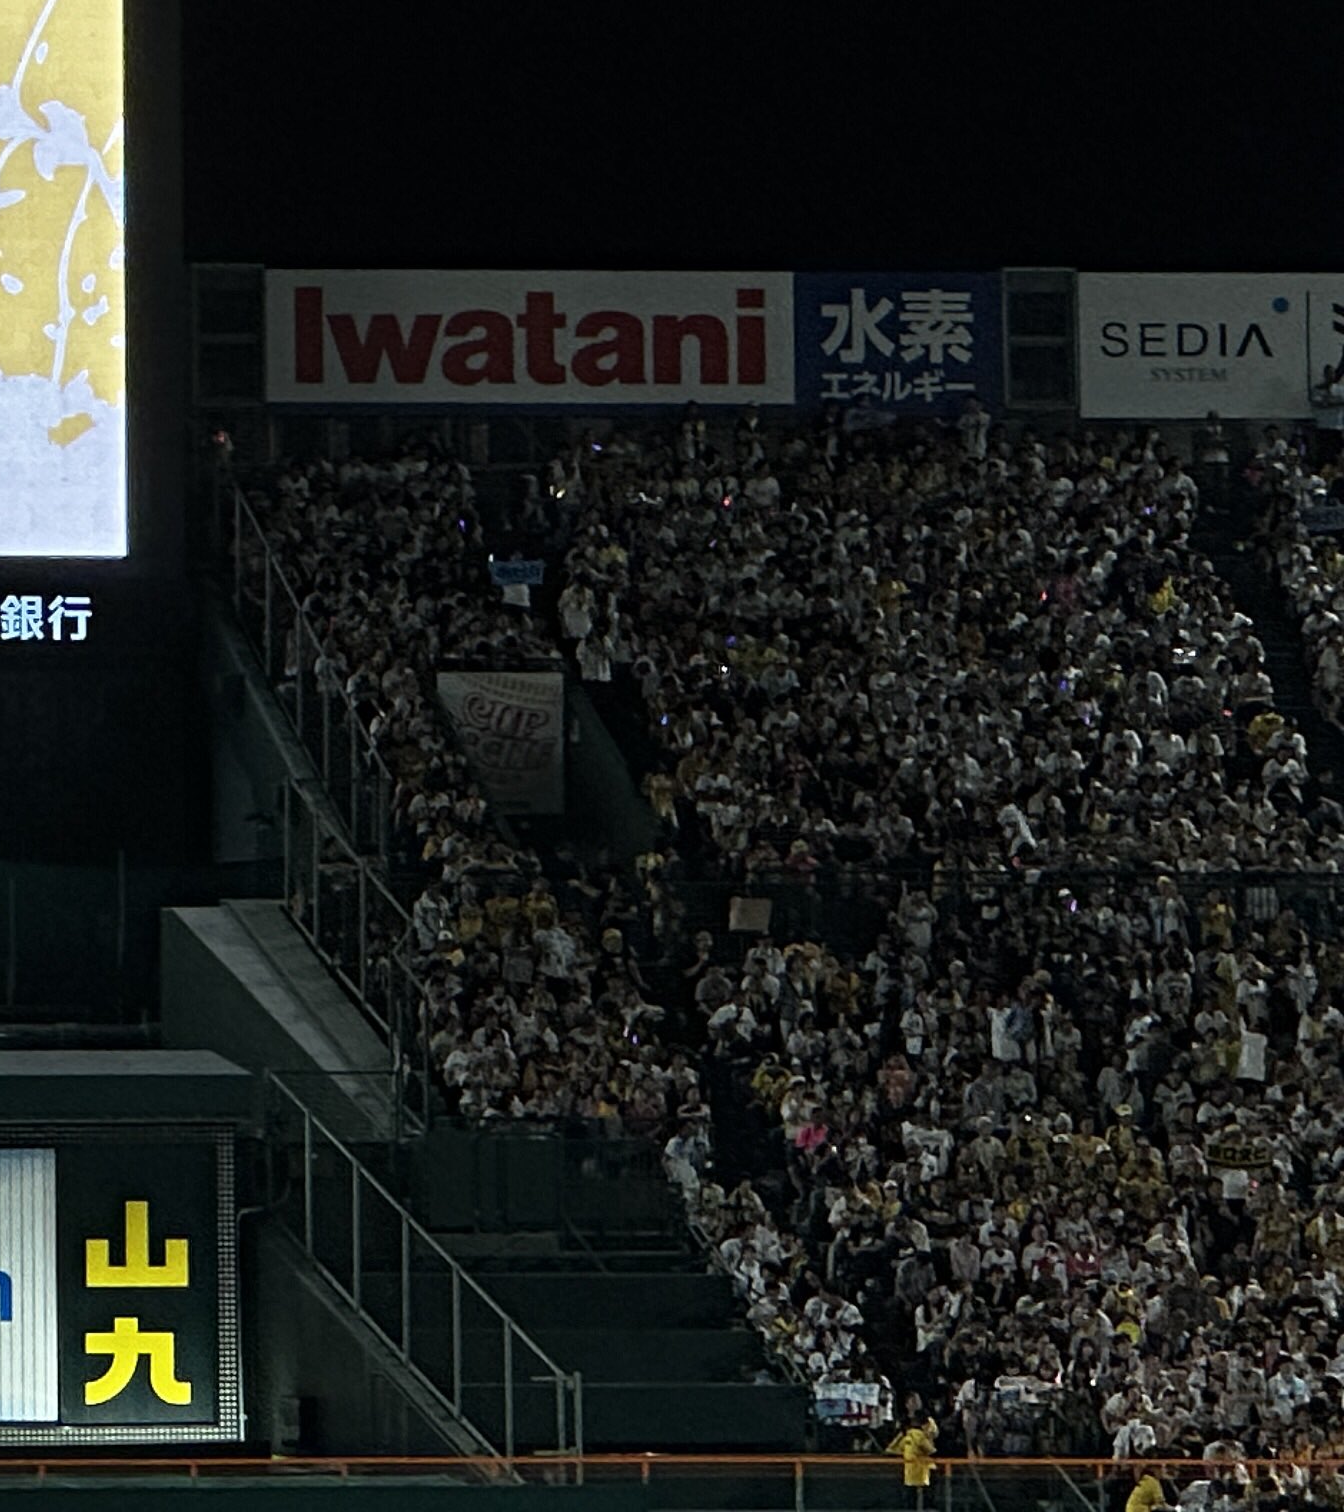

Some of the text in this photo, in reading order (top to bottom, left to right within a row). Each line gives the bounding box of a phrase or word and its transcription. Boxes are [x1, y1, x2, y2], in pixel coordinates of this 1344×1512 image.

[294, 287, 766, 386] Iwatani
[820, 288, 974, 363] 水素
[1100, 322, 1273, 357] SEDIA
[819, 369, 976, 403] エネルギー
[1150, 367, 1229, 383] SYSTEM
[84, 1201, 189, 1405] 山九
